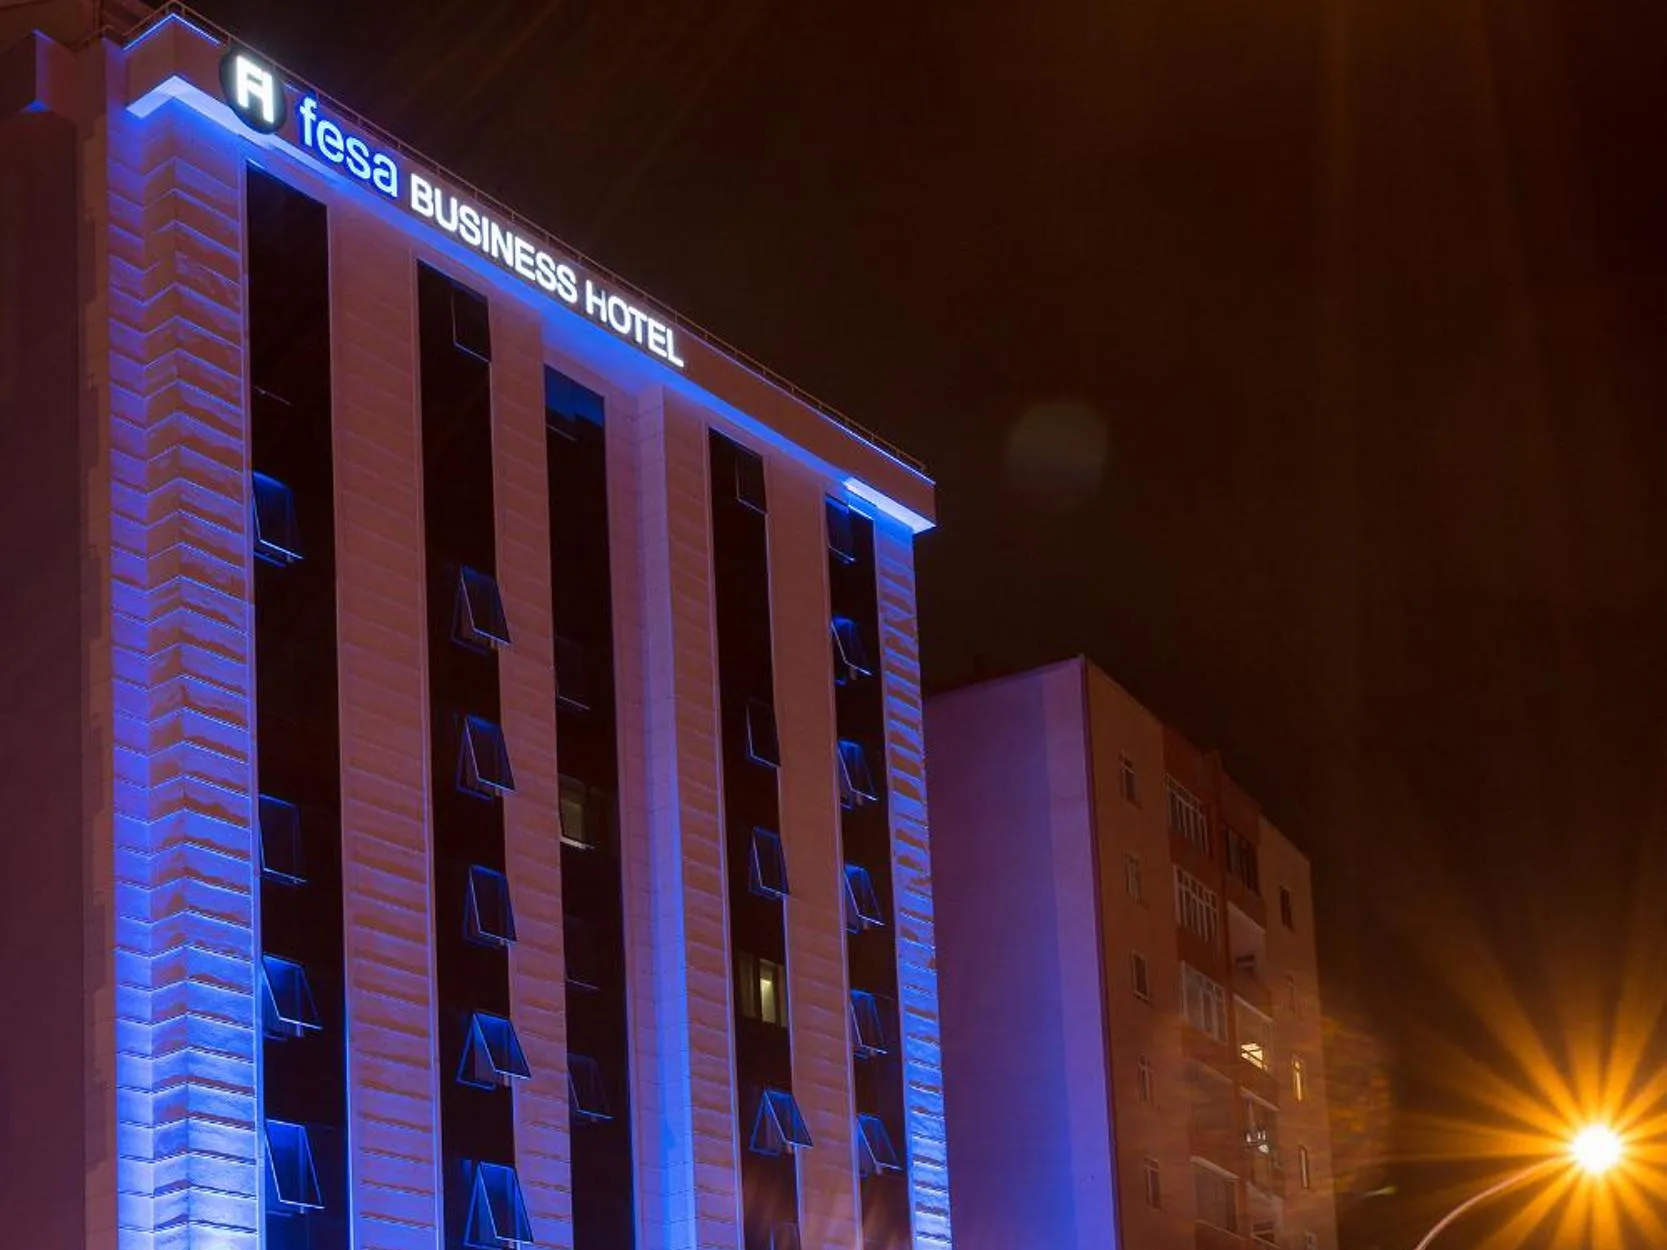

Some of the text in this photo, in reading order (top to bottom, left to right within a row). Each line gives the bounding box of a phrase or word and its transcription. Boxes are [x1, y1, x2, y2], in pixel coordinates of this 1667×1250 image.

[300, 97, 684, 368] fesa BUSINESS HOTEL
